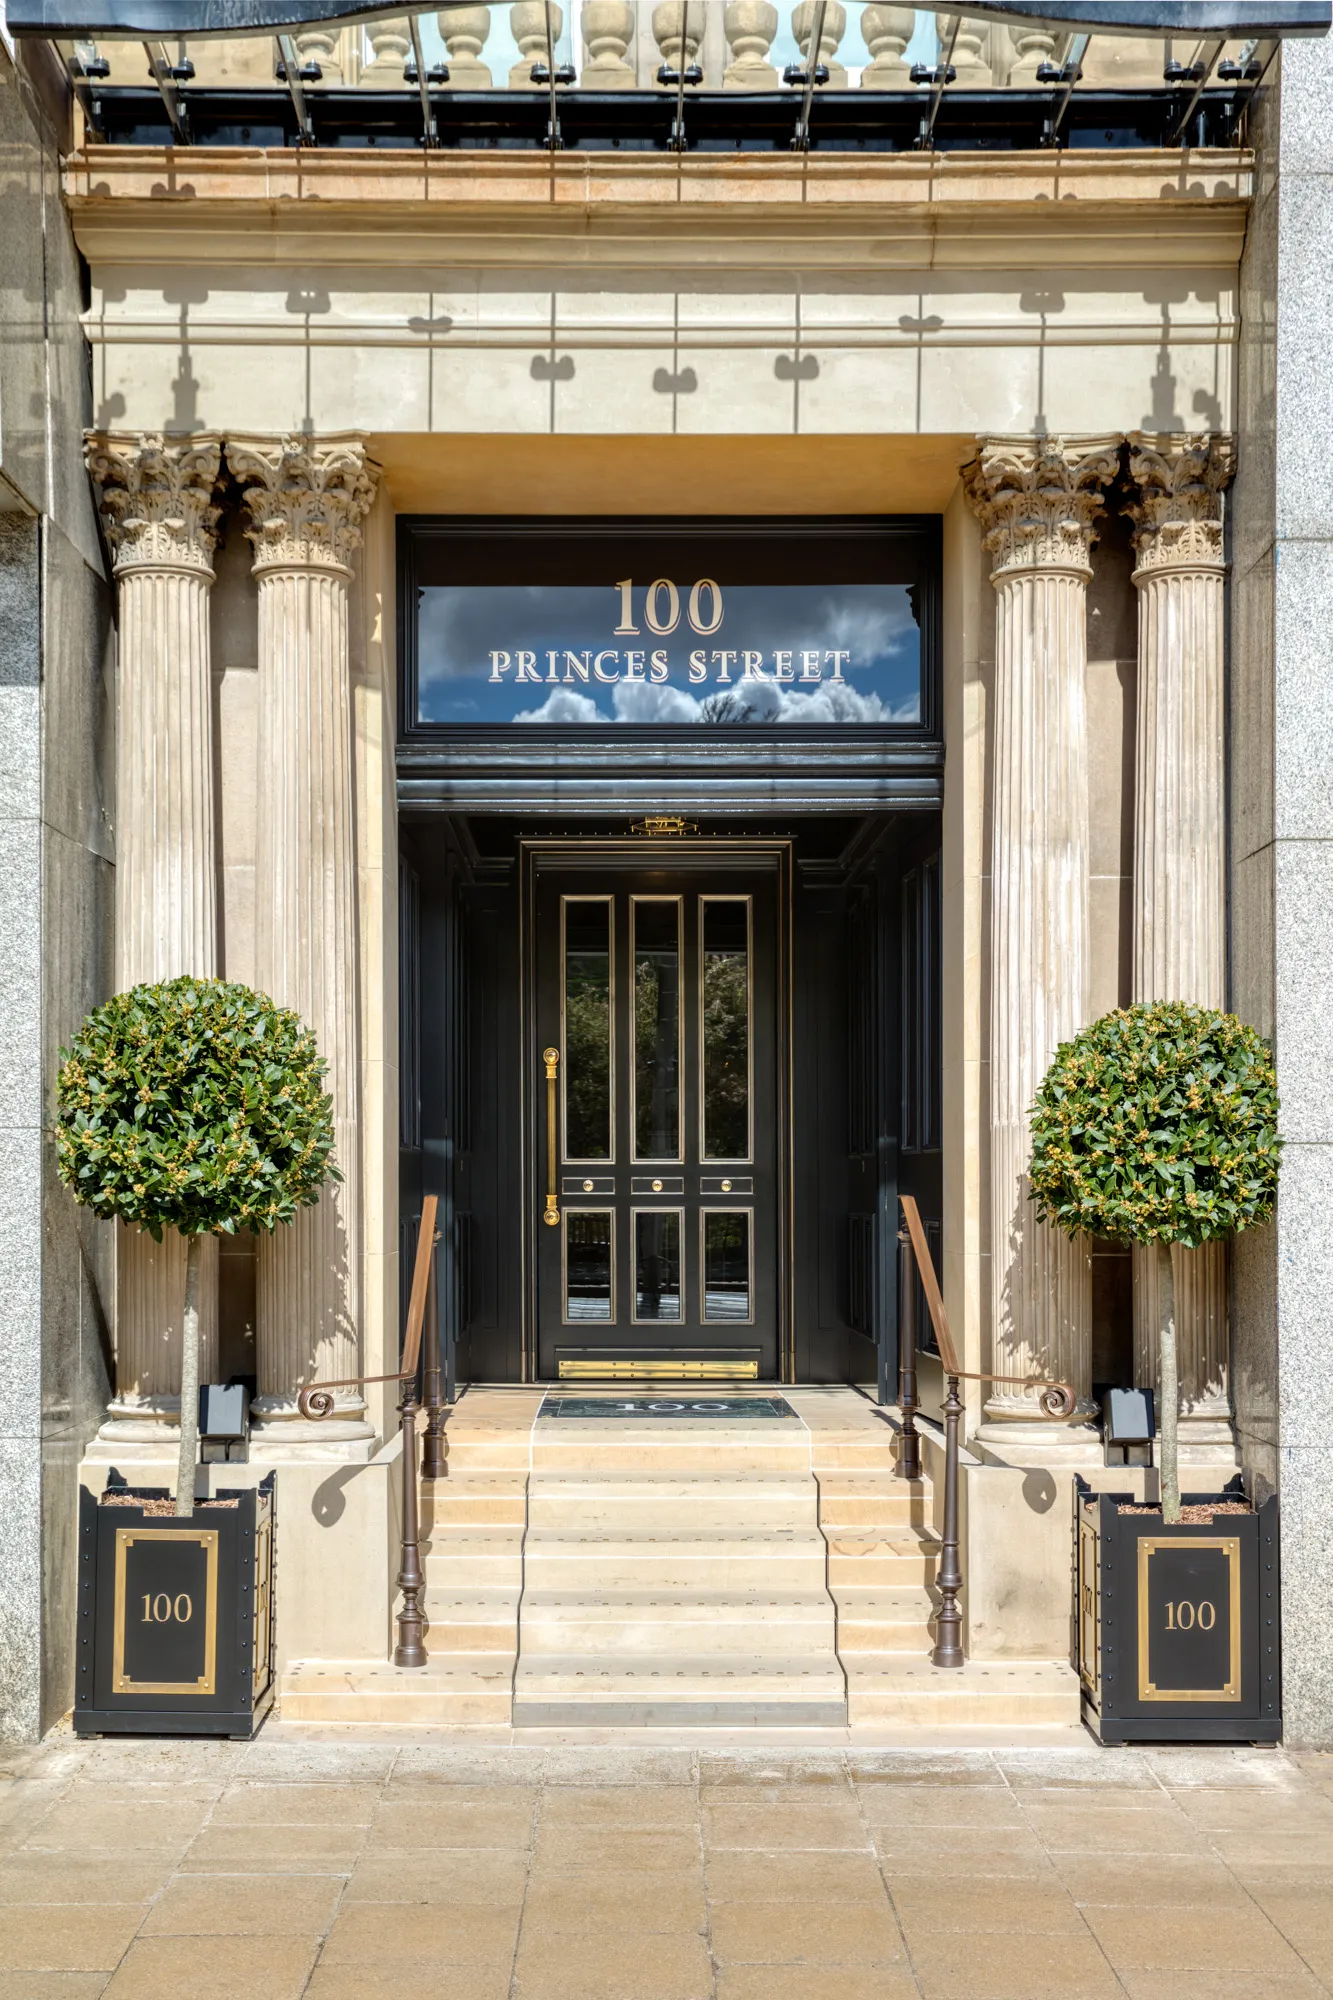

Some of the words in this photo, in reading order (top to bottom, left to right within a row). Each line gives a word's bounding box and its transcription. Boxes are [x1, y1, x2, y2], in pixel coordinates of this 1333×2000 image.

[614, 578, 725, 636] 100
[488, 650, 669, 683] PRINCES
[688, 650, 851, 683] STREET
[616, 1403, 728, 1411] 100
[141, 1593, 193, 1623] 100
[1164, 1601, 1216, 1630] 100
